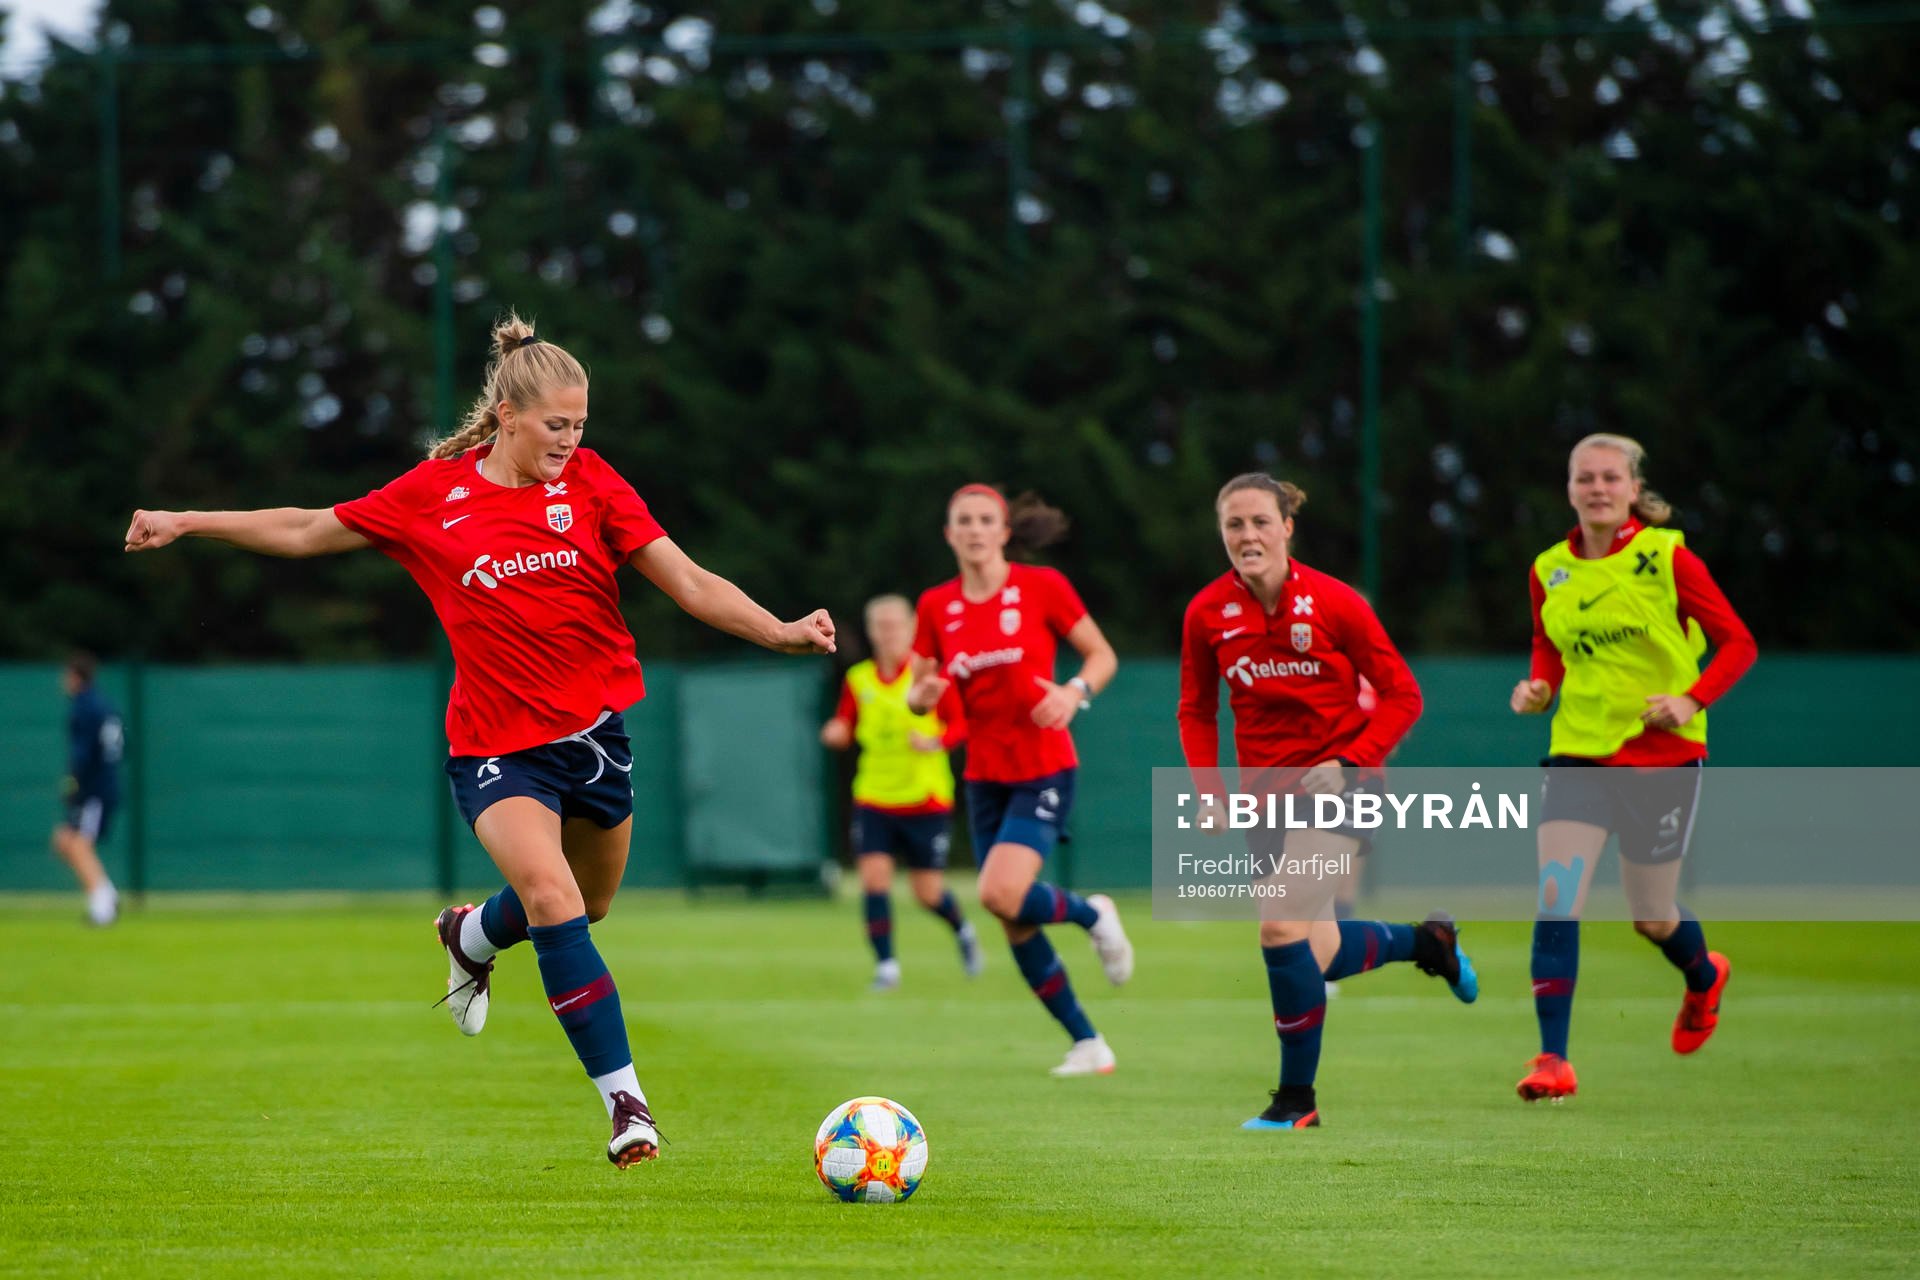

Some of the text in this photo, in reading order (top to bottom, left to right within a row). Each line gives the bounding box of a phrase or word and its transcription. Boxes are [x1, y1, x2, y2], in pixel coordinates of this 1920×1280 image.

[491, 549, 579, 579] telenor
[1250, 658, 1322, 678] telenor
[478, 774, 503, 790] telenor
